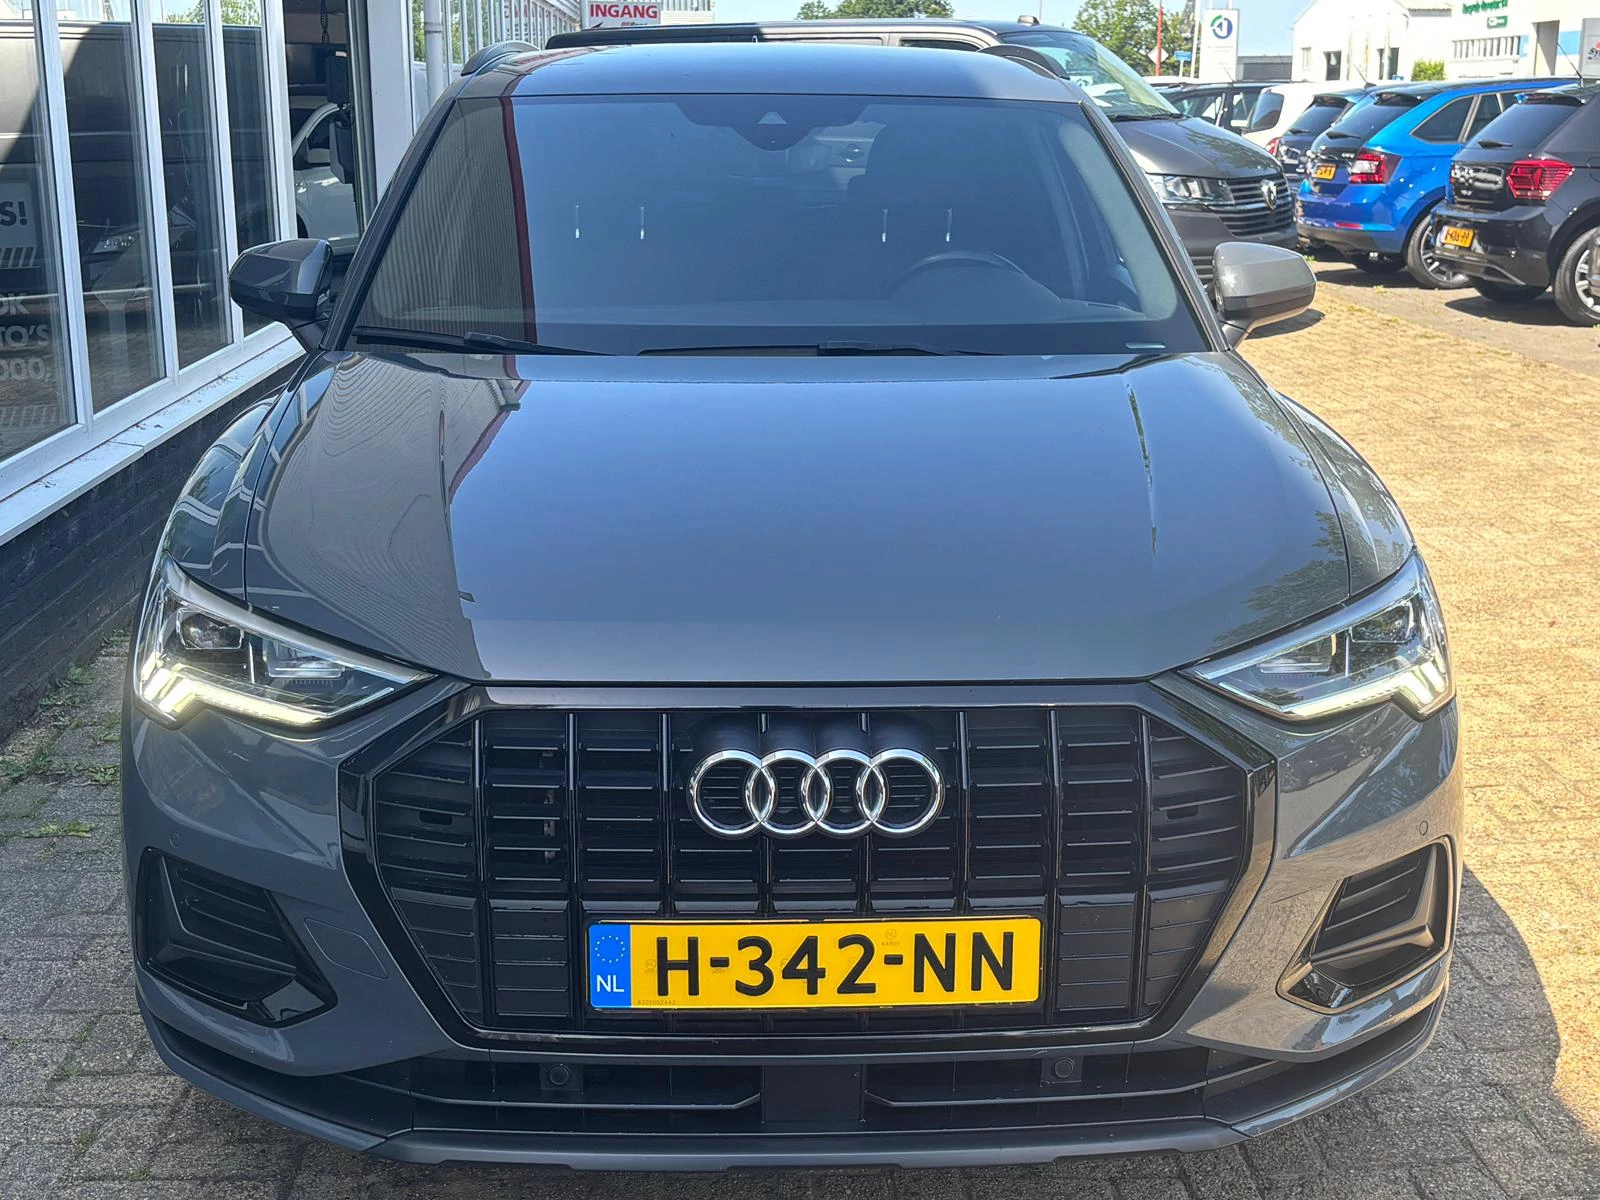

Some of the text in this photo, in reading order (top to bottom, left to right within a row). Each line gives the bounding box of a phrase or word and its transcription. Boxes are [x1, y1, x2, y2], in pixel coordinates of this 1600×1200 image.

[590, 4, 658, 18] INGANG
[656, 931, 1014, 996] H-342-NN
[596, 974, 625, 993] NL
